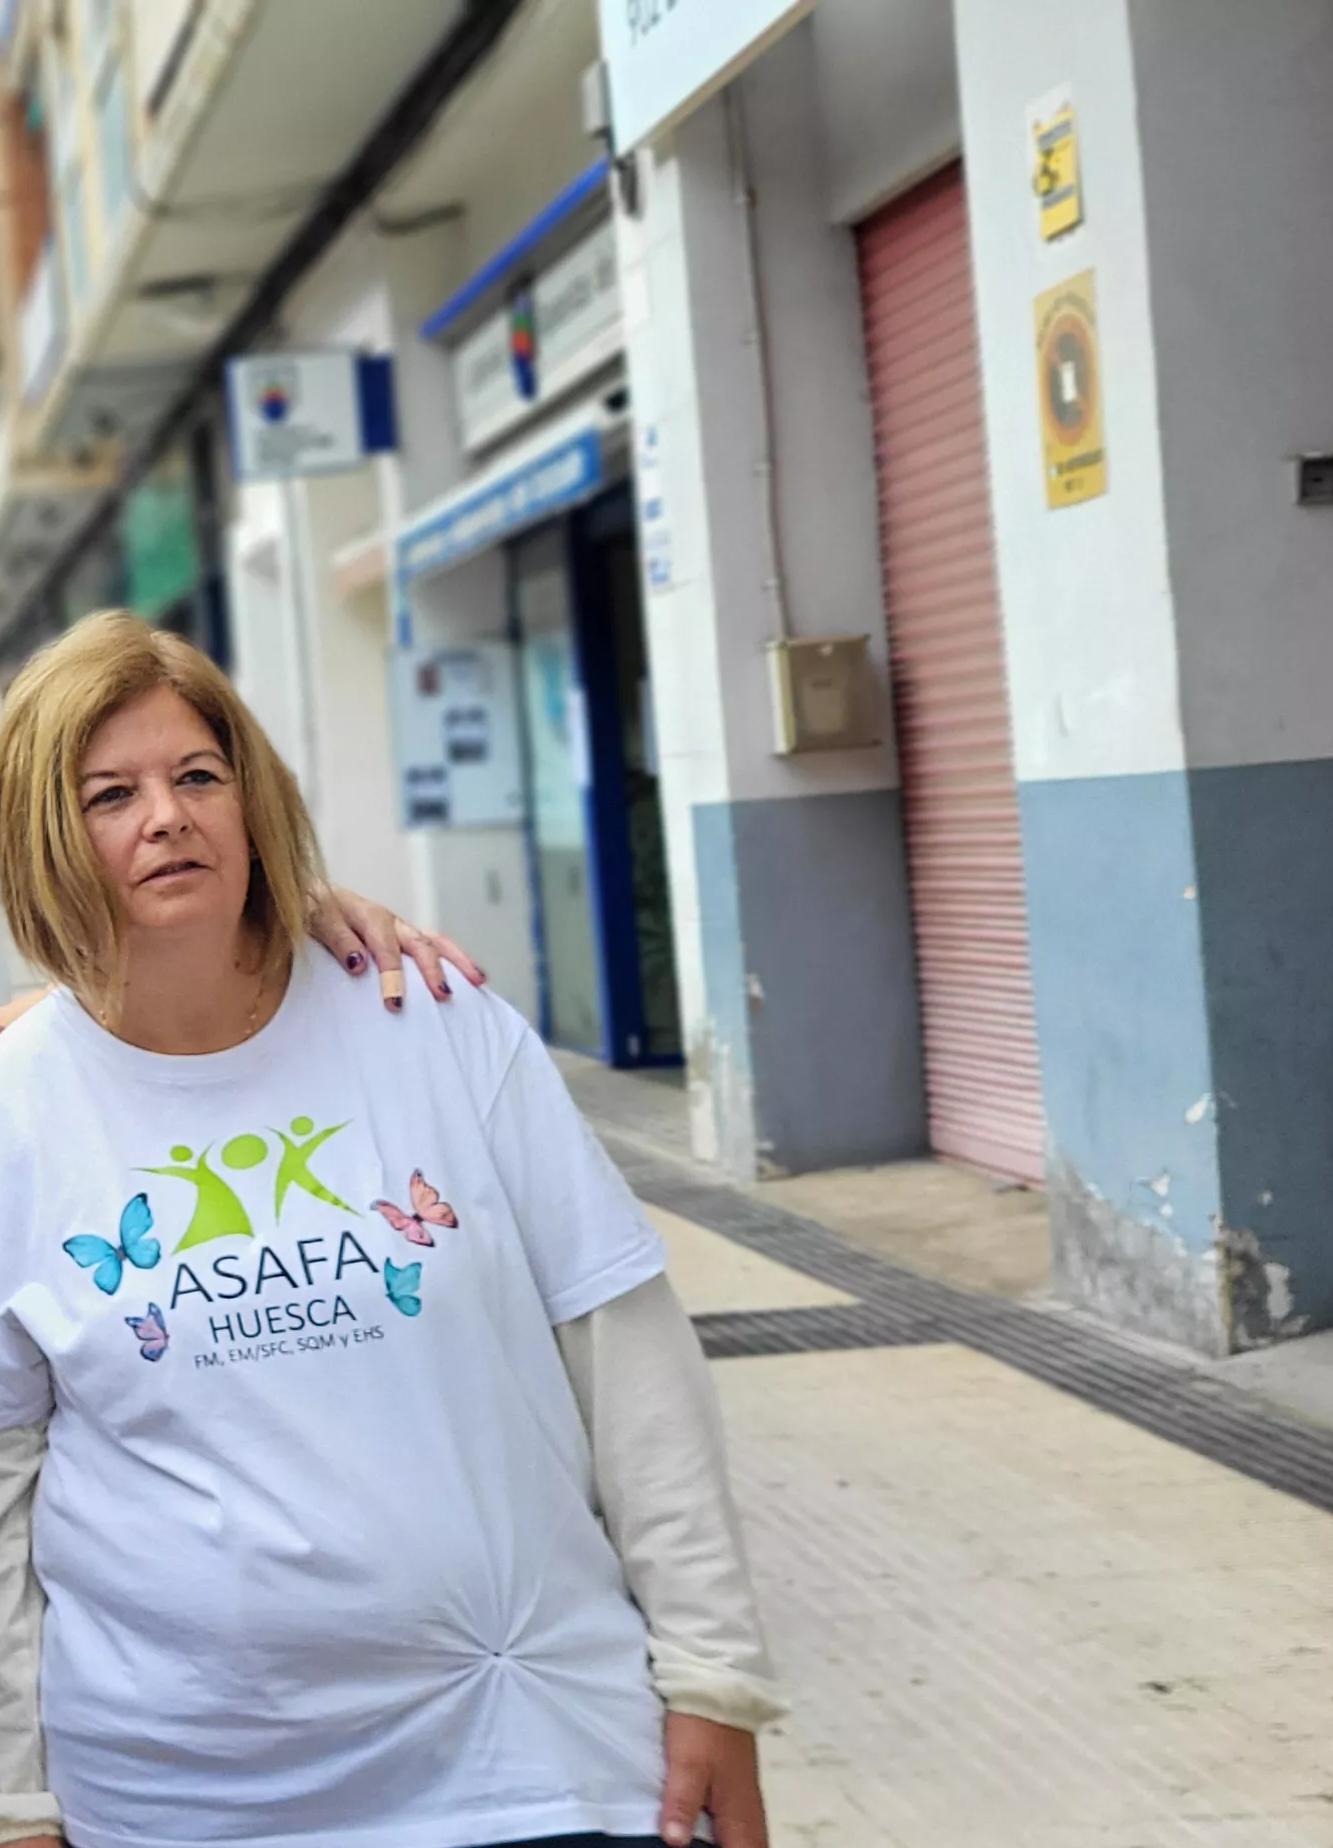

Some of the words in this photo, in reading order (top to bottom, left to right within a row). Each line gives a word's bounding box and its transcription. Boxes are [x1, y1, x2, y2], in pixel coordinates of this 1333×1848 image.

[170, 1231, 379, 1309] ASAFA
[209, 1295, 357, 1343] HUESCA
[194, 1354, 225, 1369] FM,
[229, 1341, 294, 1362] EM/SFC,
[297, 1333, 334, 1351] SQM
[340, 1336, 348, 1347] y
[353, 1325, 384, 1341] EHS
